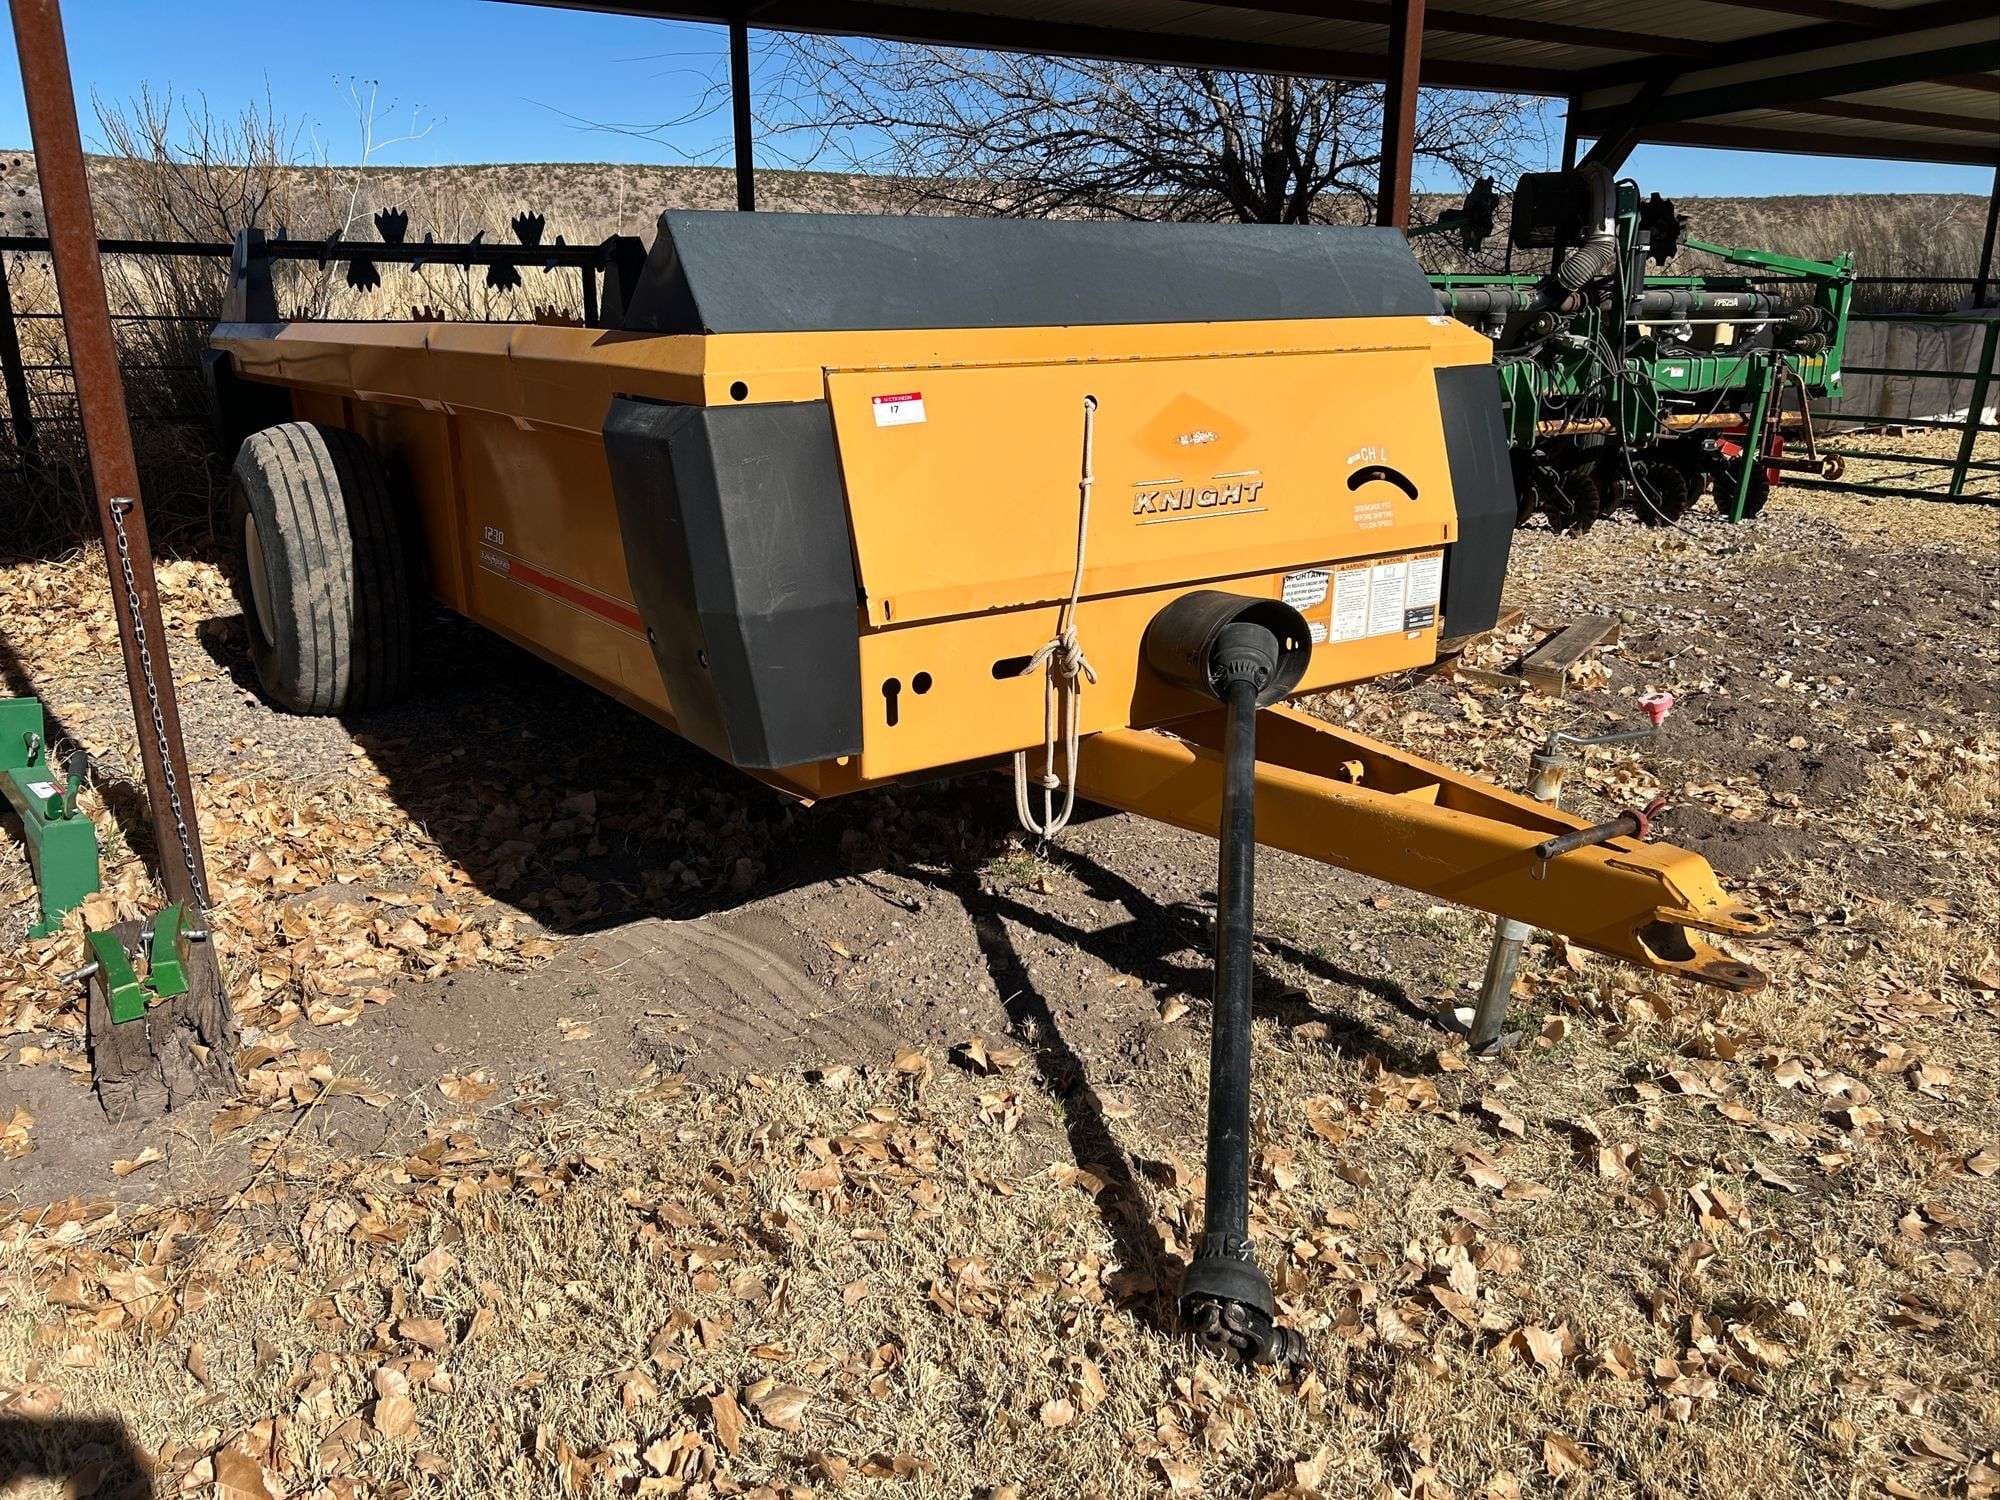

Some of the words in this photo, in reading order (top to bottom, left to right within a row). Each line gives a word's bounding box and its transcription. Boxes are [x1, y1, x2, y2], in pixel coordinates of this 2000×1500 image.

[890, 404, 899, 414] 17
[1133, 481, 1264, 515] KNIGHT
[485, 526, 504, 545] 1230
